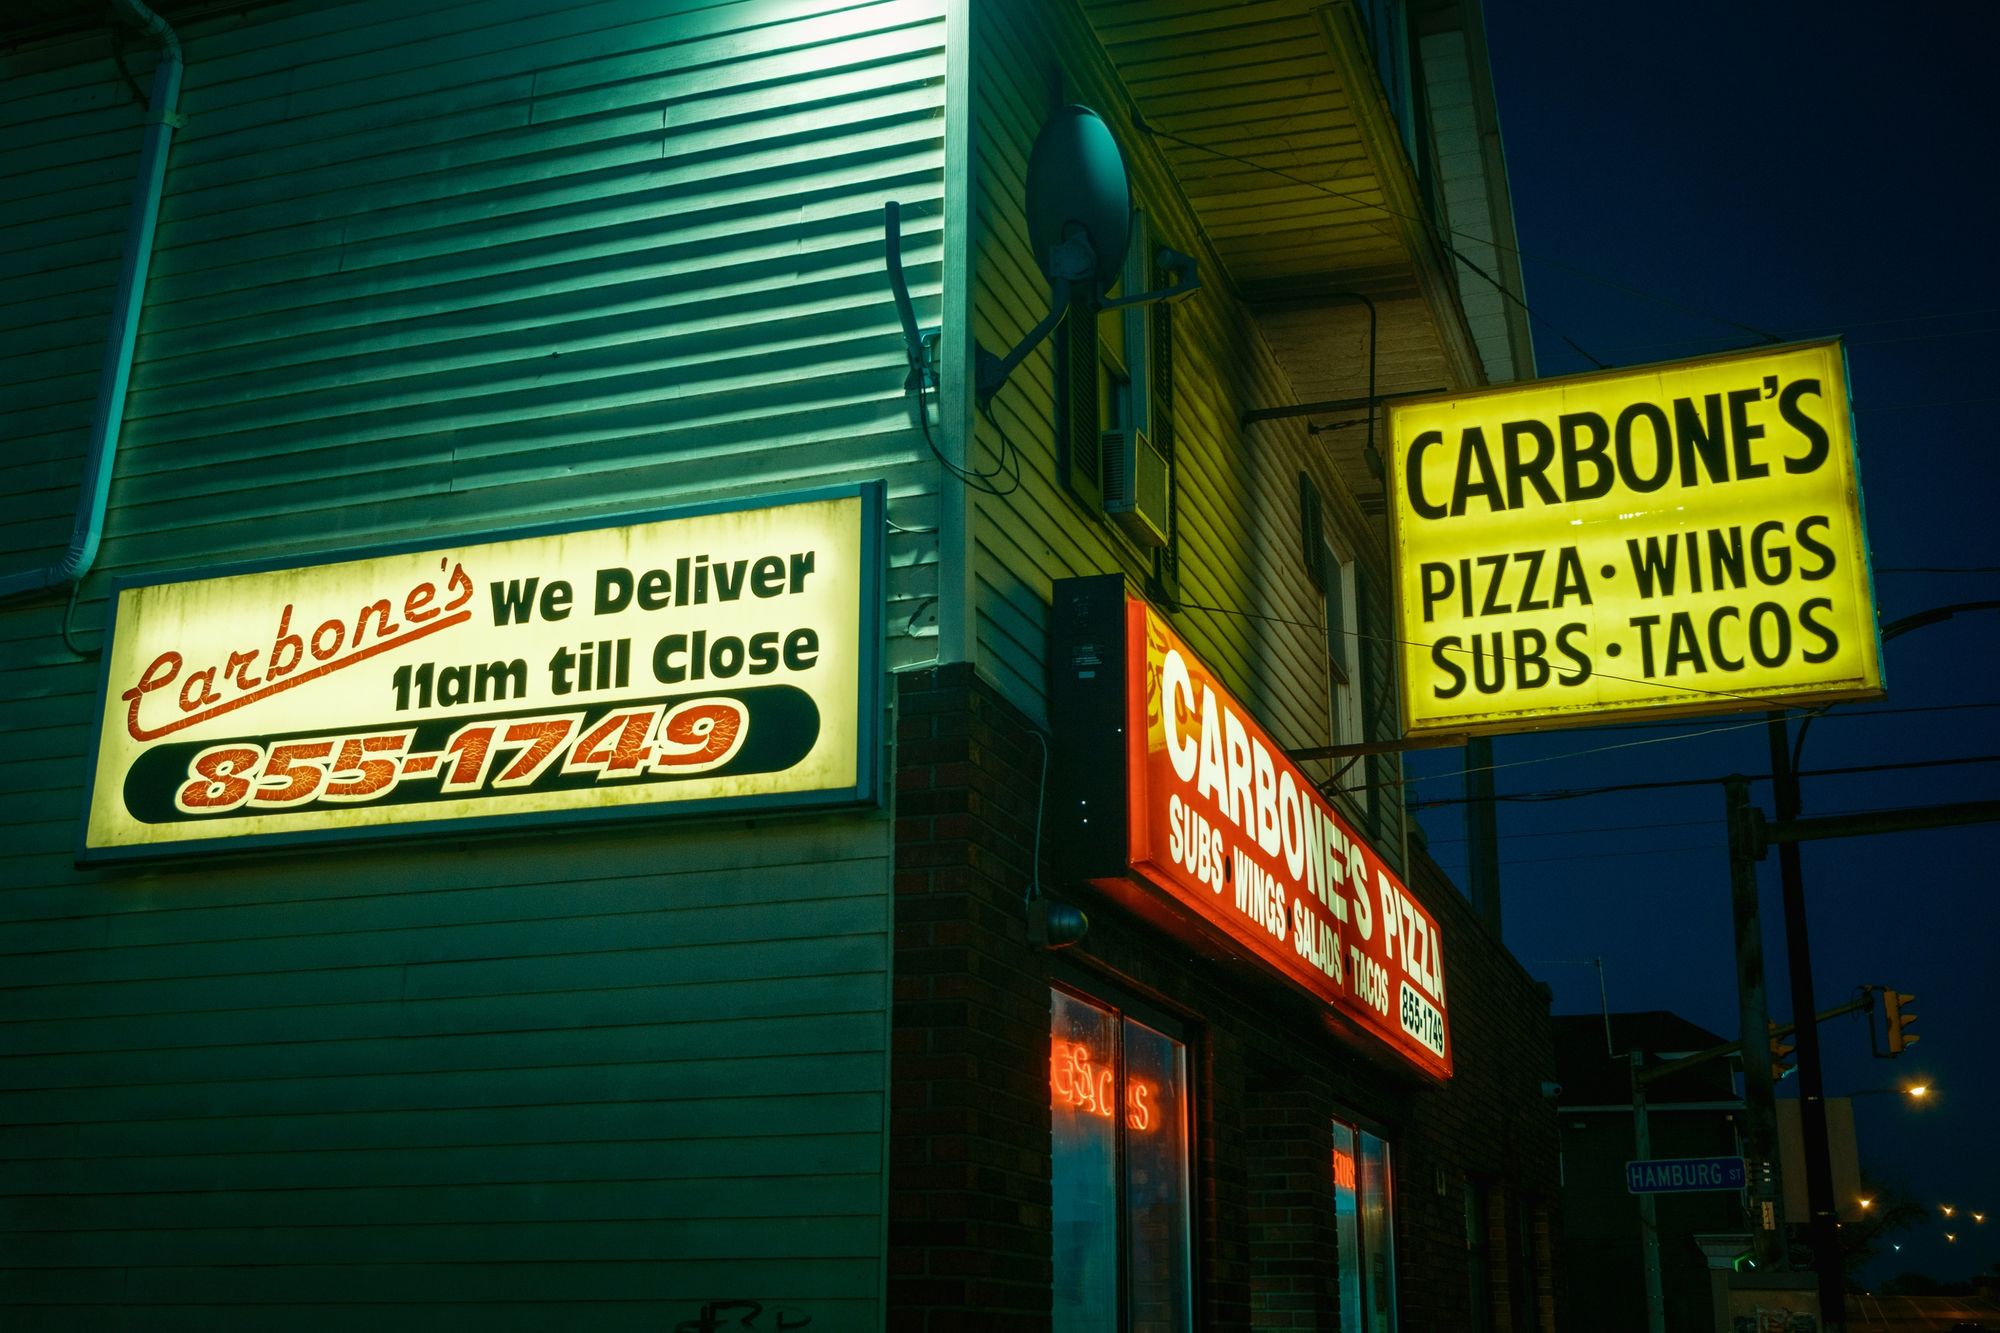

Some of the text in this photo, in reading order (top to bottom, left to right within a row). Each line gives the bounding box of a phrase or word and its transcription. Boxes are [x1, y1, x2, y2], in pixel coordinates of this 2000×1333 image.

[1405, 375, 1830, 520] CARBONE'S
[490, 550, 815, 627] We Deliver
[1420, 515, 1837, 623] PIZZA WINGS
[122, 557, 473, 742] Carbone's
[392, 627, 819, 712] 11am till Close
[1431, 597, 1839, 700] SUBS TACOS
[175, 698, 745, 815] 855-1749
[1161, 648, 1373, 942] CARBONE'S
[1377, 869, 1446, 1010] PIZZA
[1169, 793, 1389, 1017] SUBS WINGS SALADS TACOS
[1402, 986, 1443, 1053] 855-1749
[1631, 1163, 1741, 1188] HAMBURG ST
